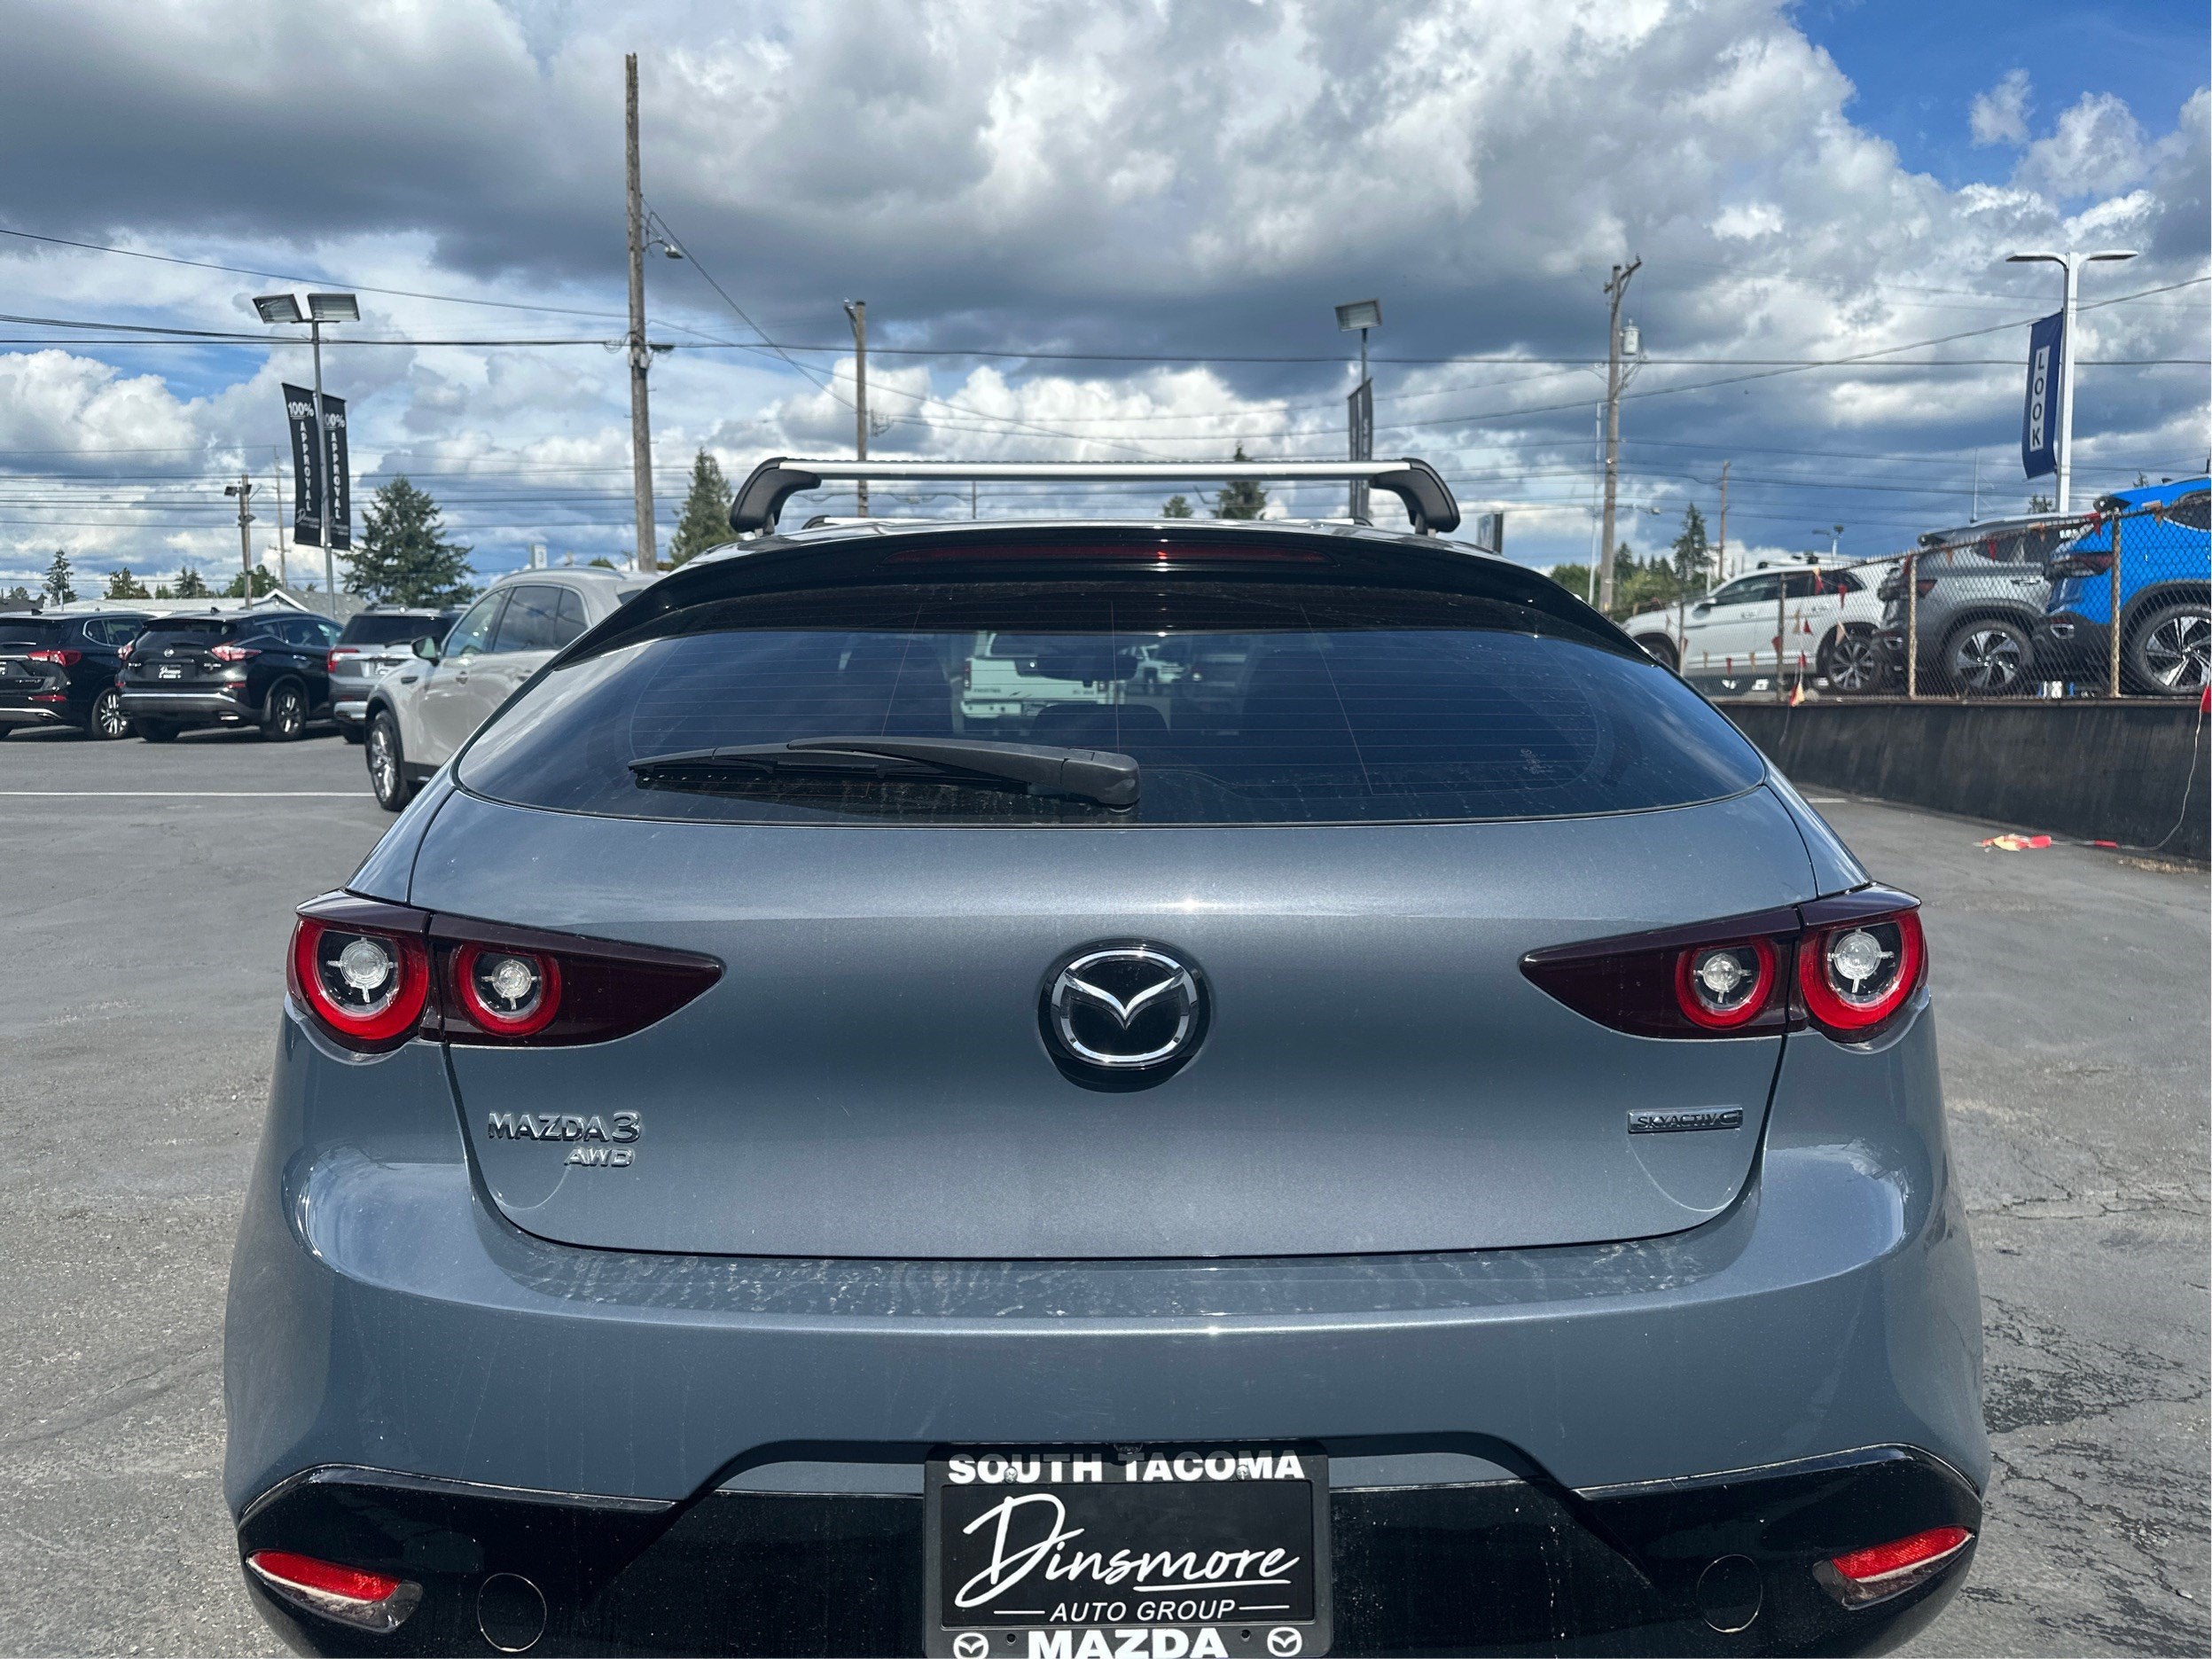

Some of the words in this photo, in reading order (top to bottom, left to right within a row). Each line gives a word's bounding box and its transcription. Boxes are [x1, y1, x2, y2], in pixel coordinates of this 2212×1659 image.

[287, 401, 315, 418] 100%
[2031, 352, 2044, 448] LOOK
[323, 412, 346, 428] 00%
[300, 420, 312, 512] APPROVAL
[331, 432, 341, 520] APPROVAL
[564, 1146, 634, 1168] AWD
[948, 1452, 1103, 1484] SOUTH
[1117, 1449, 1306, 1482] TACOMA
[955, 1493, 1300, 1608] Dinsmore
[1049, 1601, 1127, 1622] AUTO
[1137, 1599, 1236, 1621] GROUP
[1028, 1627, 1229, 1659] MAZDA
